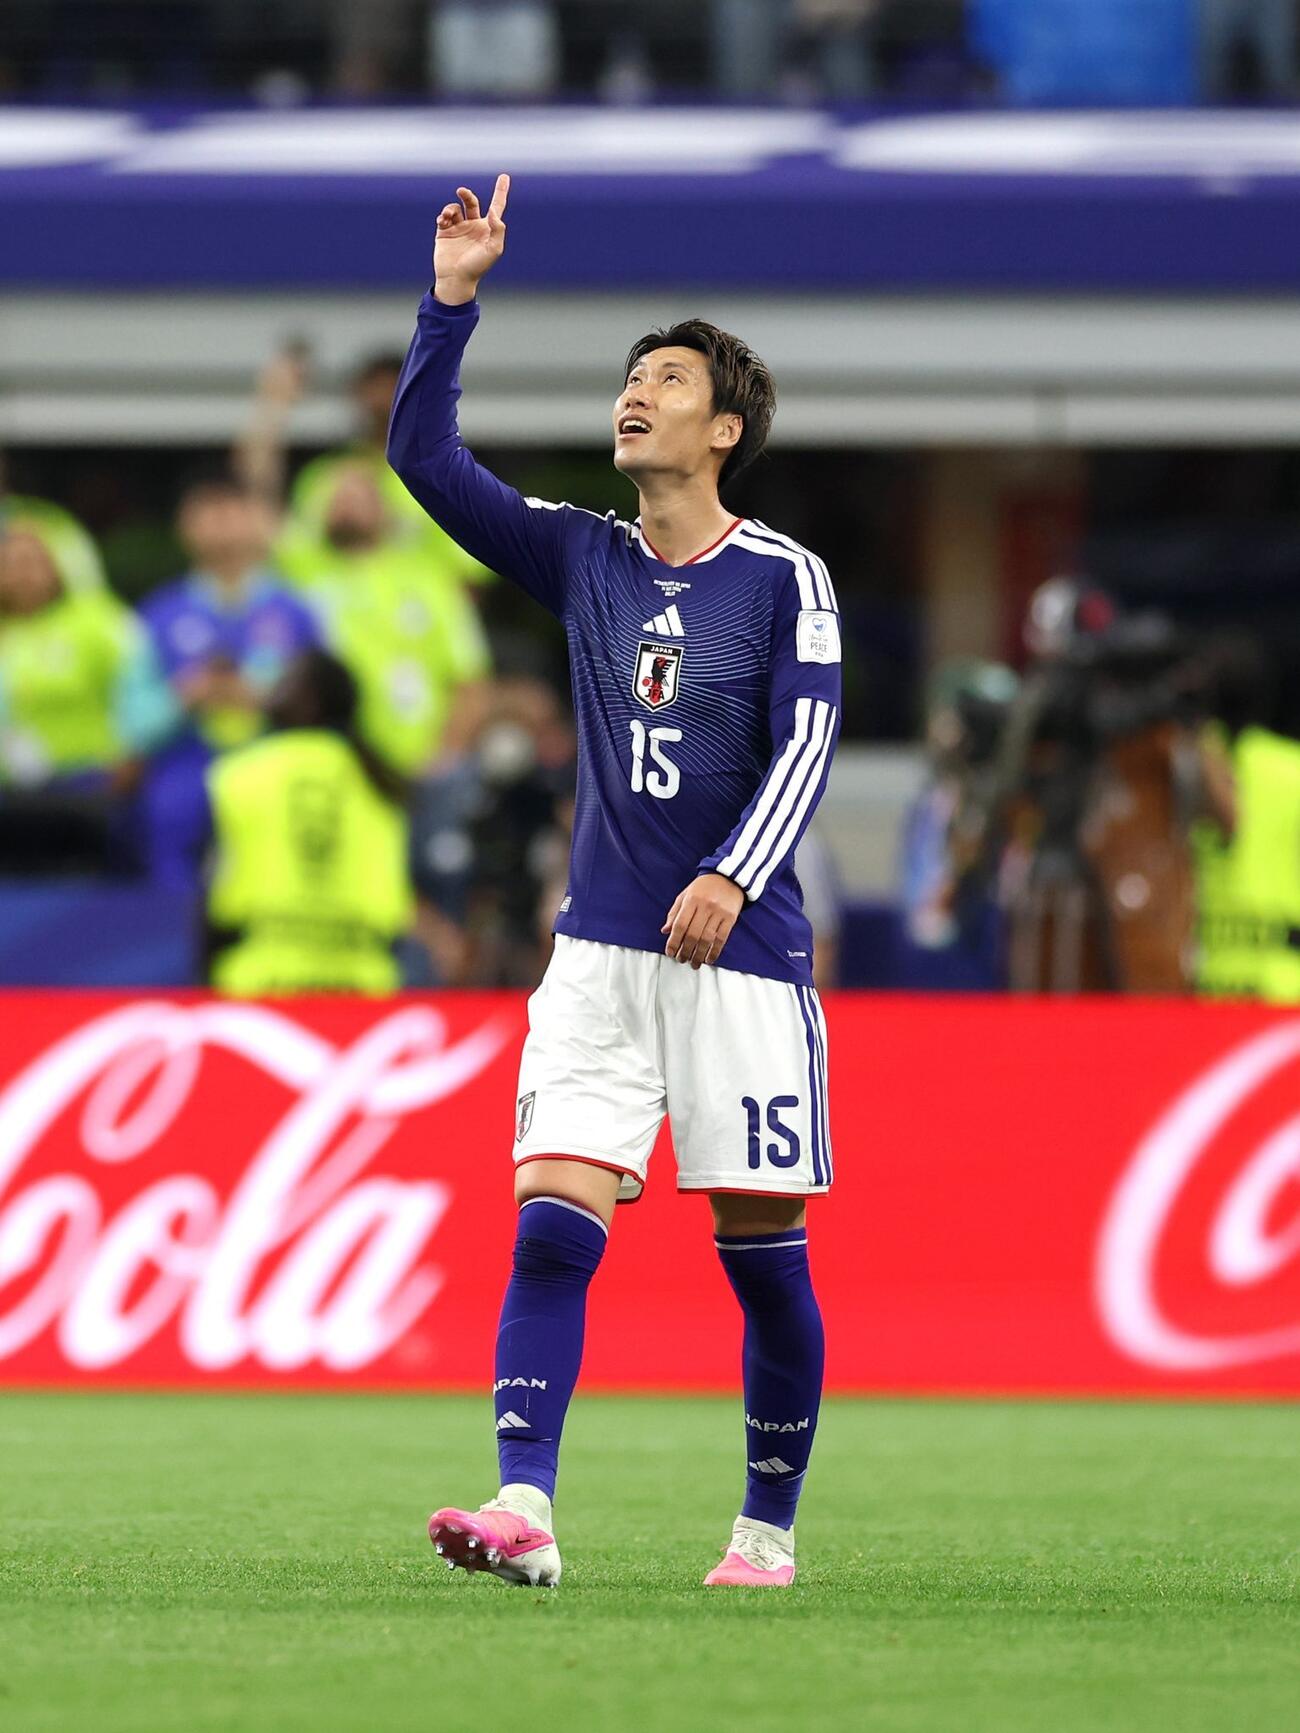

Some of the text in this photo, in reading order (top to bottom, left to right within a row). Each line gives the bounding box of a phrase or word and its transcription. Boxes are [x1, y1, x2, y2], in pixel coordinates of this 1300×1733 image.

[650, 645, 673, 655] JAPAN
[629, 719, 683, 799] 15
[741, 1095, 801, 1170] 15
